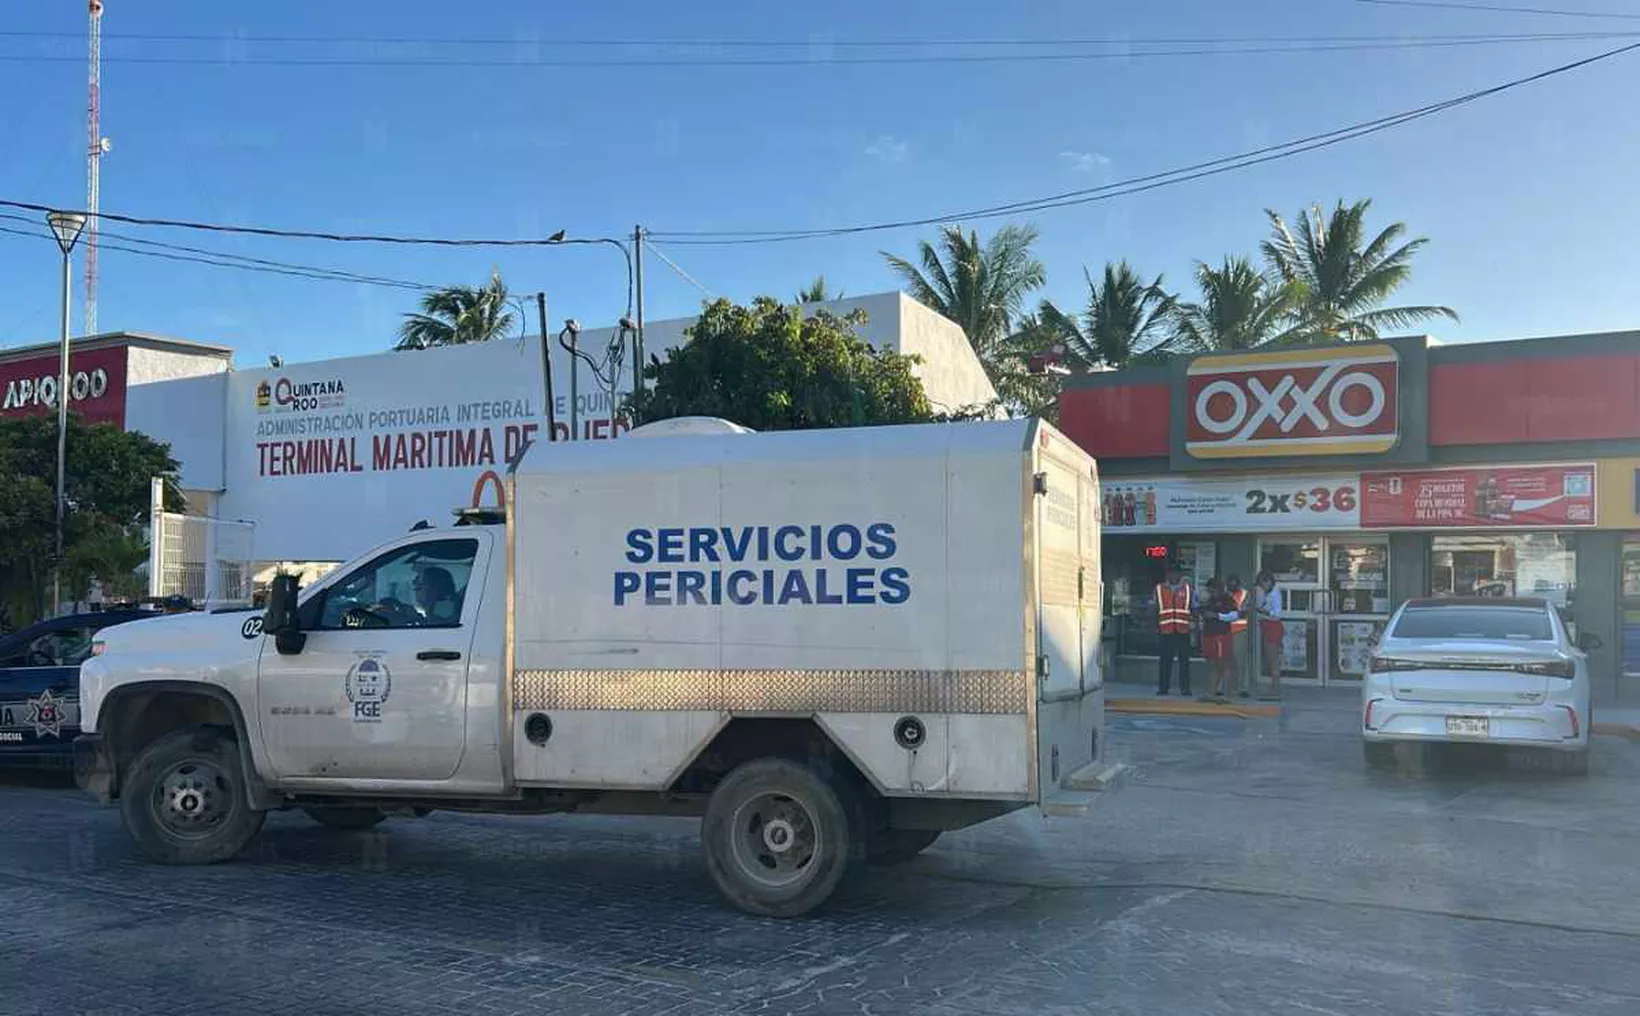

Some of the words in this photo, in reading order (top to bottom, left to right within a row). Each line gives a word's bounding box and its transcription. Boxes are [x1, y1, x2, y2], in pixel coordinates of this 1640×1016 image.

[275, 378, 344, 405] QUINTANA
[293, 398, 318, 411] ROO
[1195, 367, 1385, 440] OXXO
[369, 405, 450, 428] PORTUARIA
[457, 399, 535, 422] INTEGRAL
[257, 437, 364, 476] TERMINAL
[373, 427, 495, 471] MARITIMA
[625, 523, 897, 563] SERVICIOS
[614, 567, 911, 606] PERICIALES
[244, 619, 263, 635] 02
[355, 701, 381, 717] FGE
